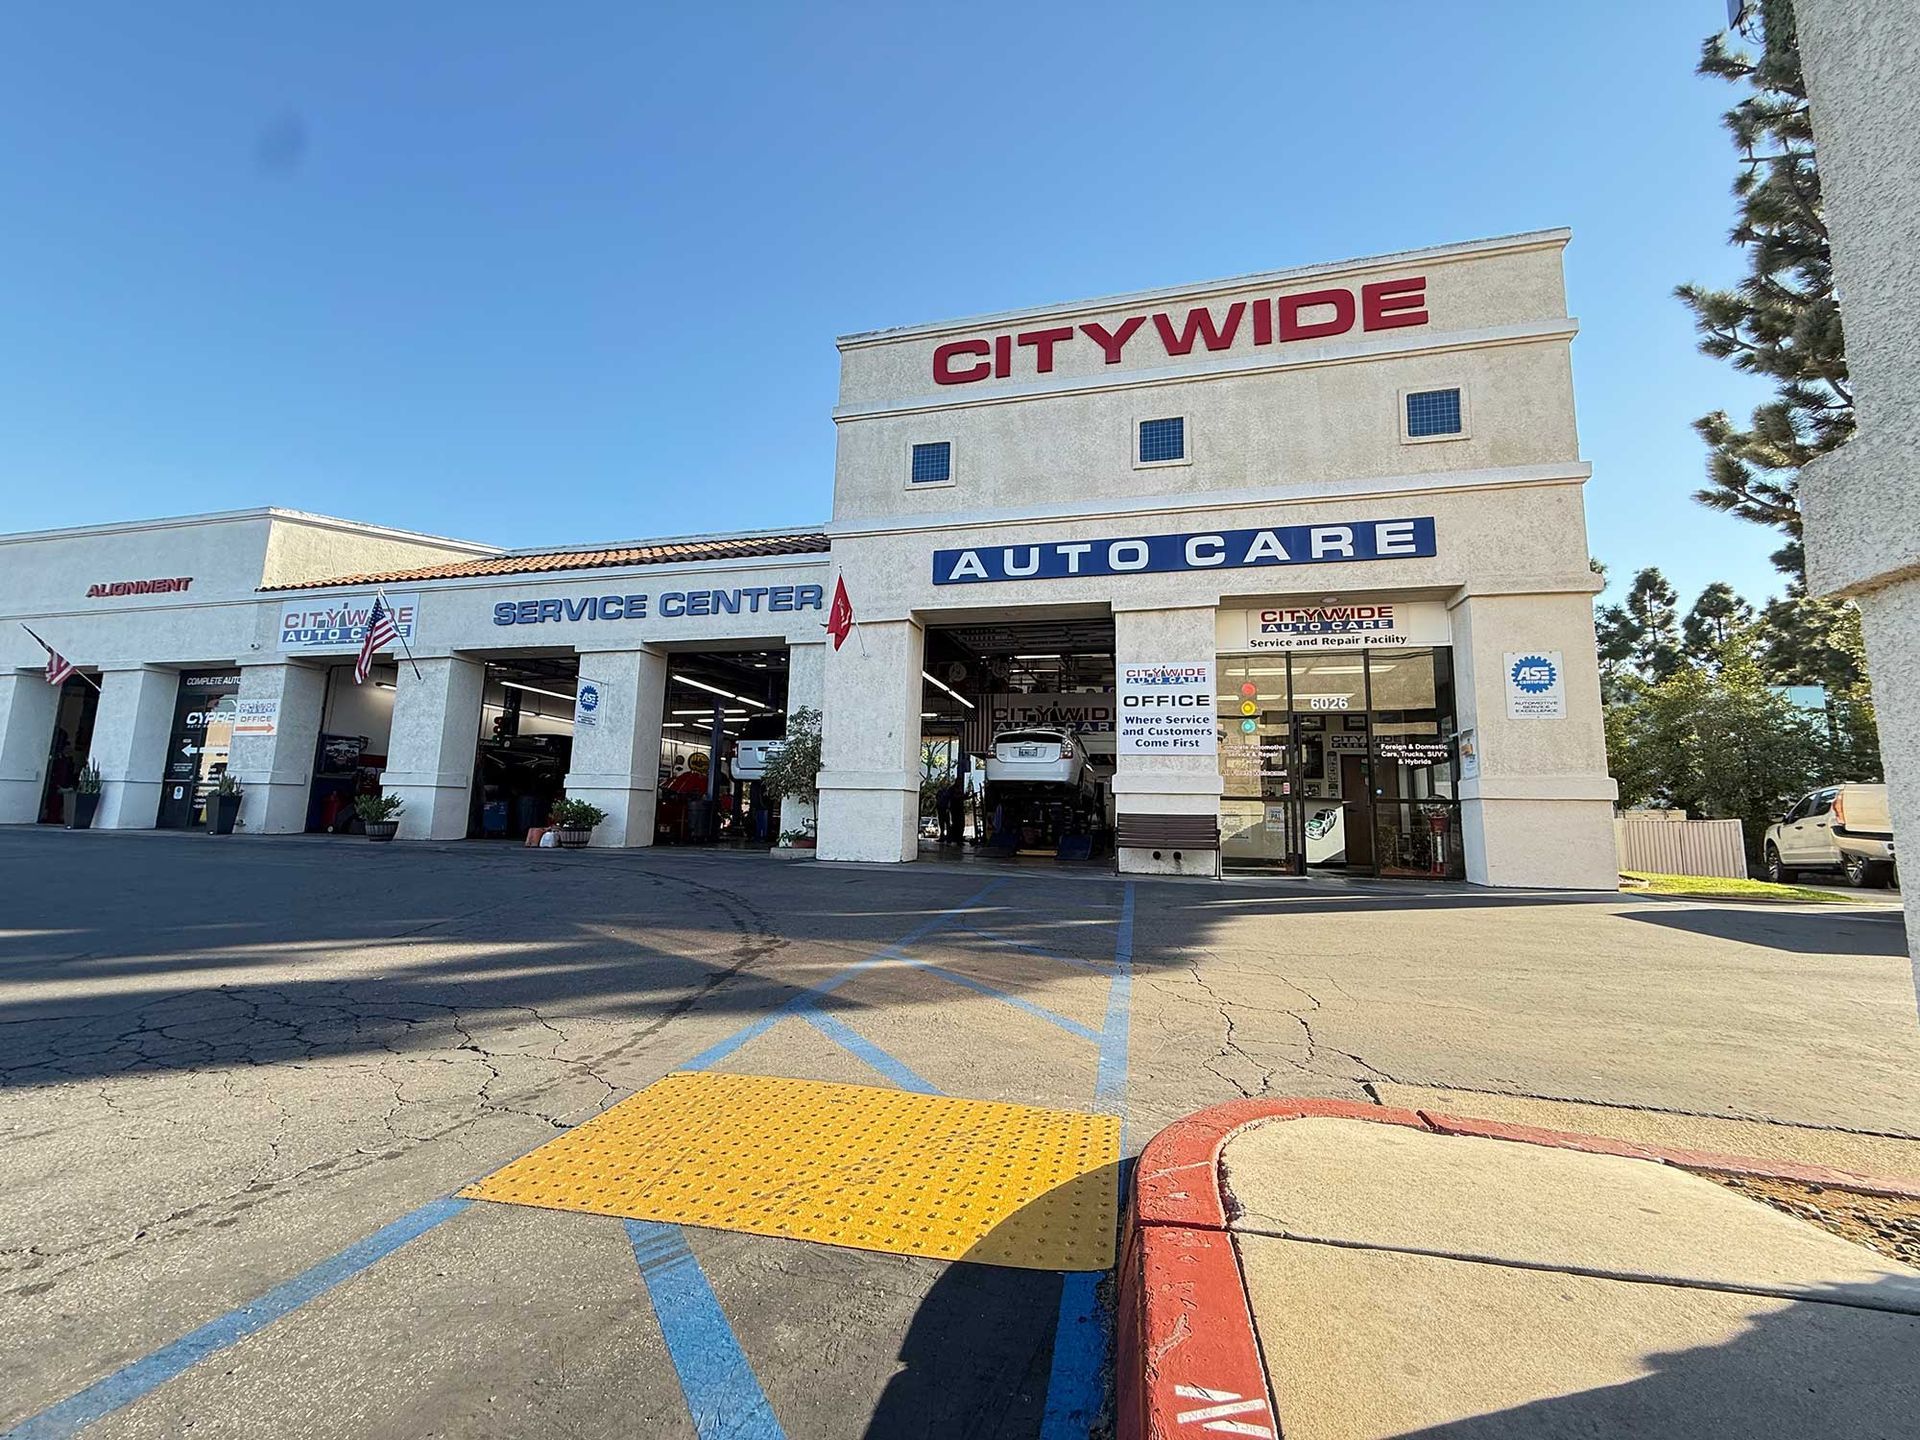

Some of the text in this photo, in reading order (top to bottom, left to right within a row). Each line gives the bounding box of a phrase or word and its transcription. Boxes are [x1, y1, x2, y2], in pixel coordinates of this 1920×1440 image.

[932, 276, 1429, 385] CITYWIDE
[948, 521, 1418, 580] AUTO CARE
[85, 577, 194, 598] ALIGNMENT
[493, 594, 648, 626] SERVICE
[658, 584, 823, 617] CENTER
[284, 606, 414, 629] CITYWDE
[1260, 606, 1393, 623] CITYWIDE
[1266, 620, 1390, 632] AUTO CARE
[286, 624, 409, 642] AUTO CE
[1250, 634, 1408, 648] Service and Repair Facility
[1126, 668, 1206, 677] CITYWIDE
[1516, 666, 1550, 681] ASE
[186, 677, 223, 686] COMPLETE
[1123, 694, 1210, 707] OFFICE
[1310, 697, 1349, 710] 6026
[240, 715, 272, 723] OFFICE
[994, 707, 1117, 721] CITYWID
[1124, 715, 1210, 724] Where Service
[1122, 727, 1213, 736] and Customers
[1135, 738, 1200, 748] Come First
[1380, 743, 1406, 751] Foreign
[1405, 758, 1432, 766] Hybrids
